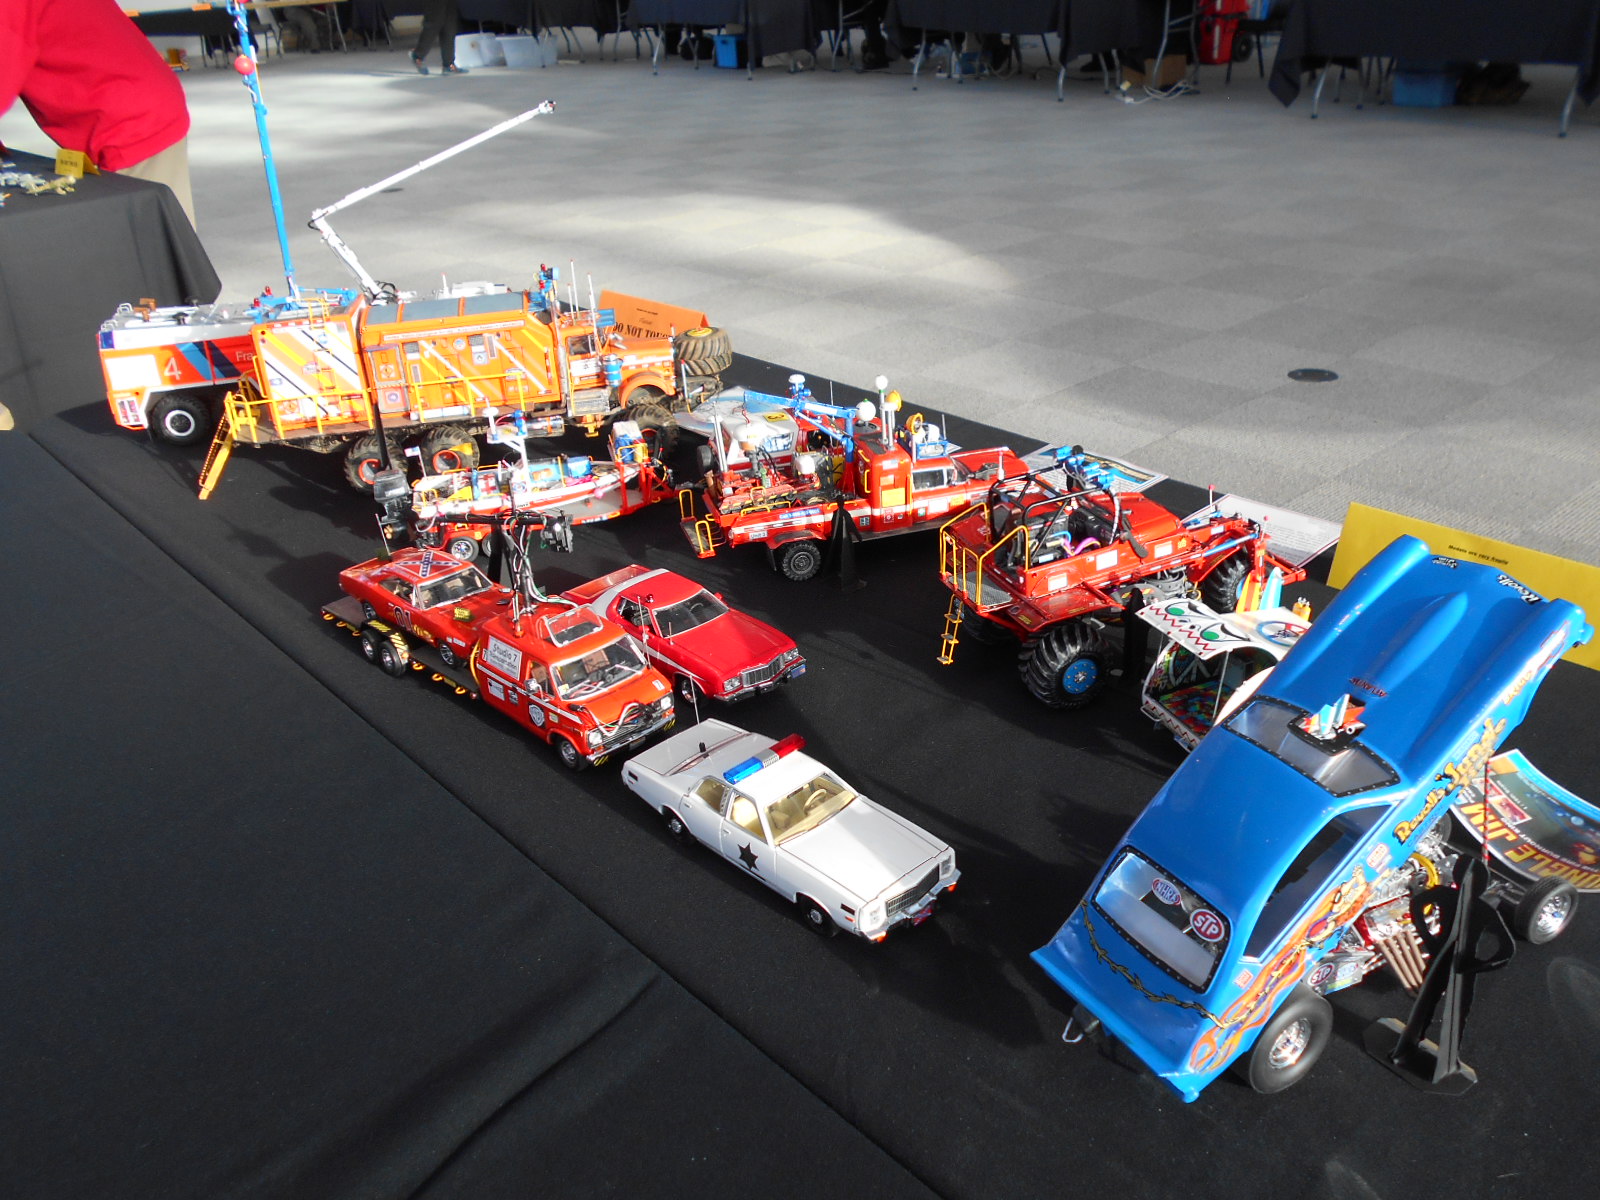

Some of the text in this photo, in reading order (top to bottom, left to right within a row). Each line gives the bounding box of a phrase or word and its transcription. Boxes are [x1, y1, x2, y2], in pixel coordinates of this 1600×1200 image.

[625, 324, 645, 338] NOT
[163, 356, 182, 381] 4
[1478, 553, 1490, 561] very
[493, 643, 512, 661] Studio
[1460, 803, 1519, 842] JIM
[1155, 881, 1179, 902] NHRA
[1193, 914, 1219, 936] STP
[1311, 965, 1333, 984] STP
